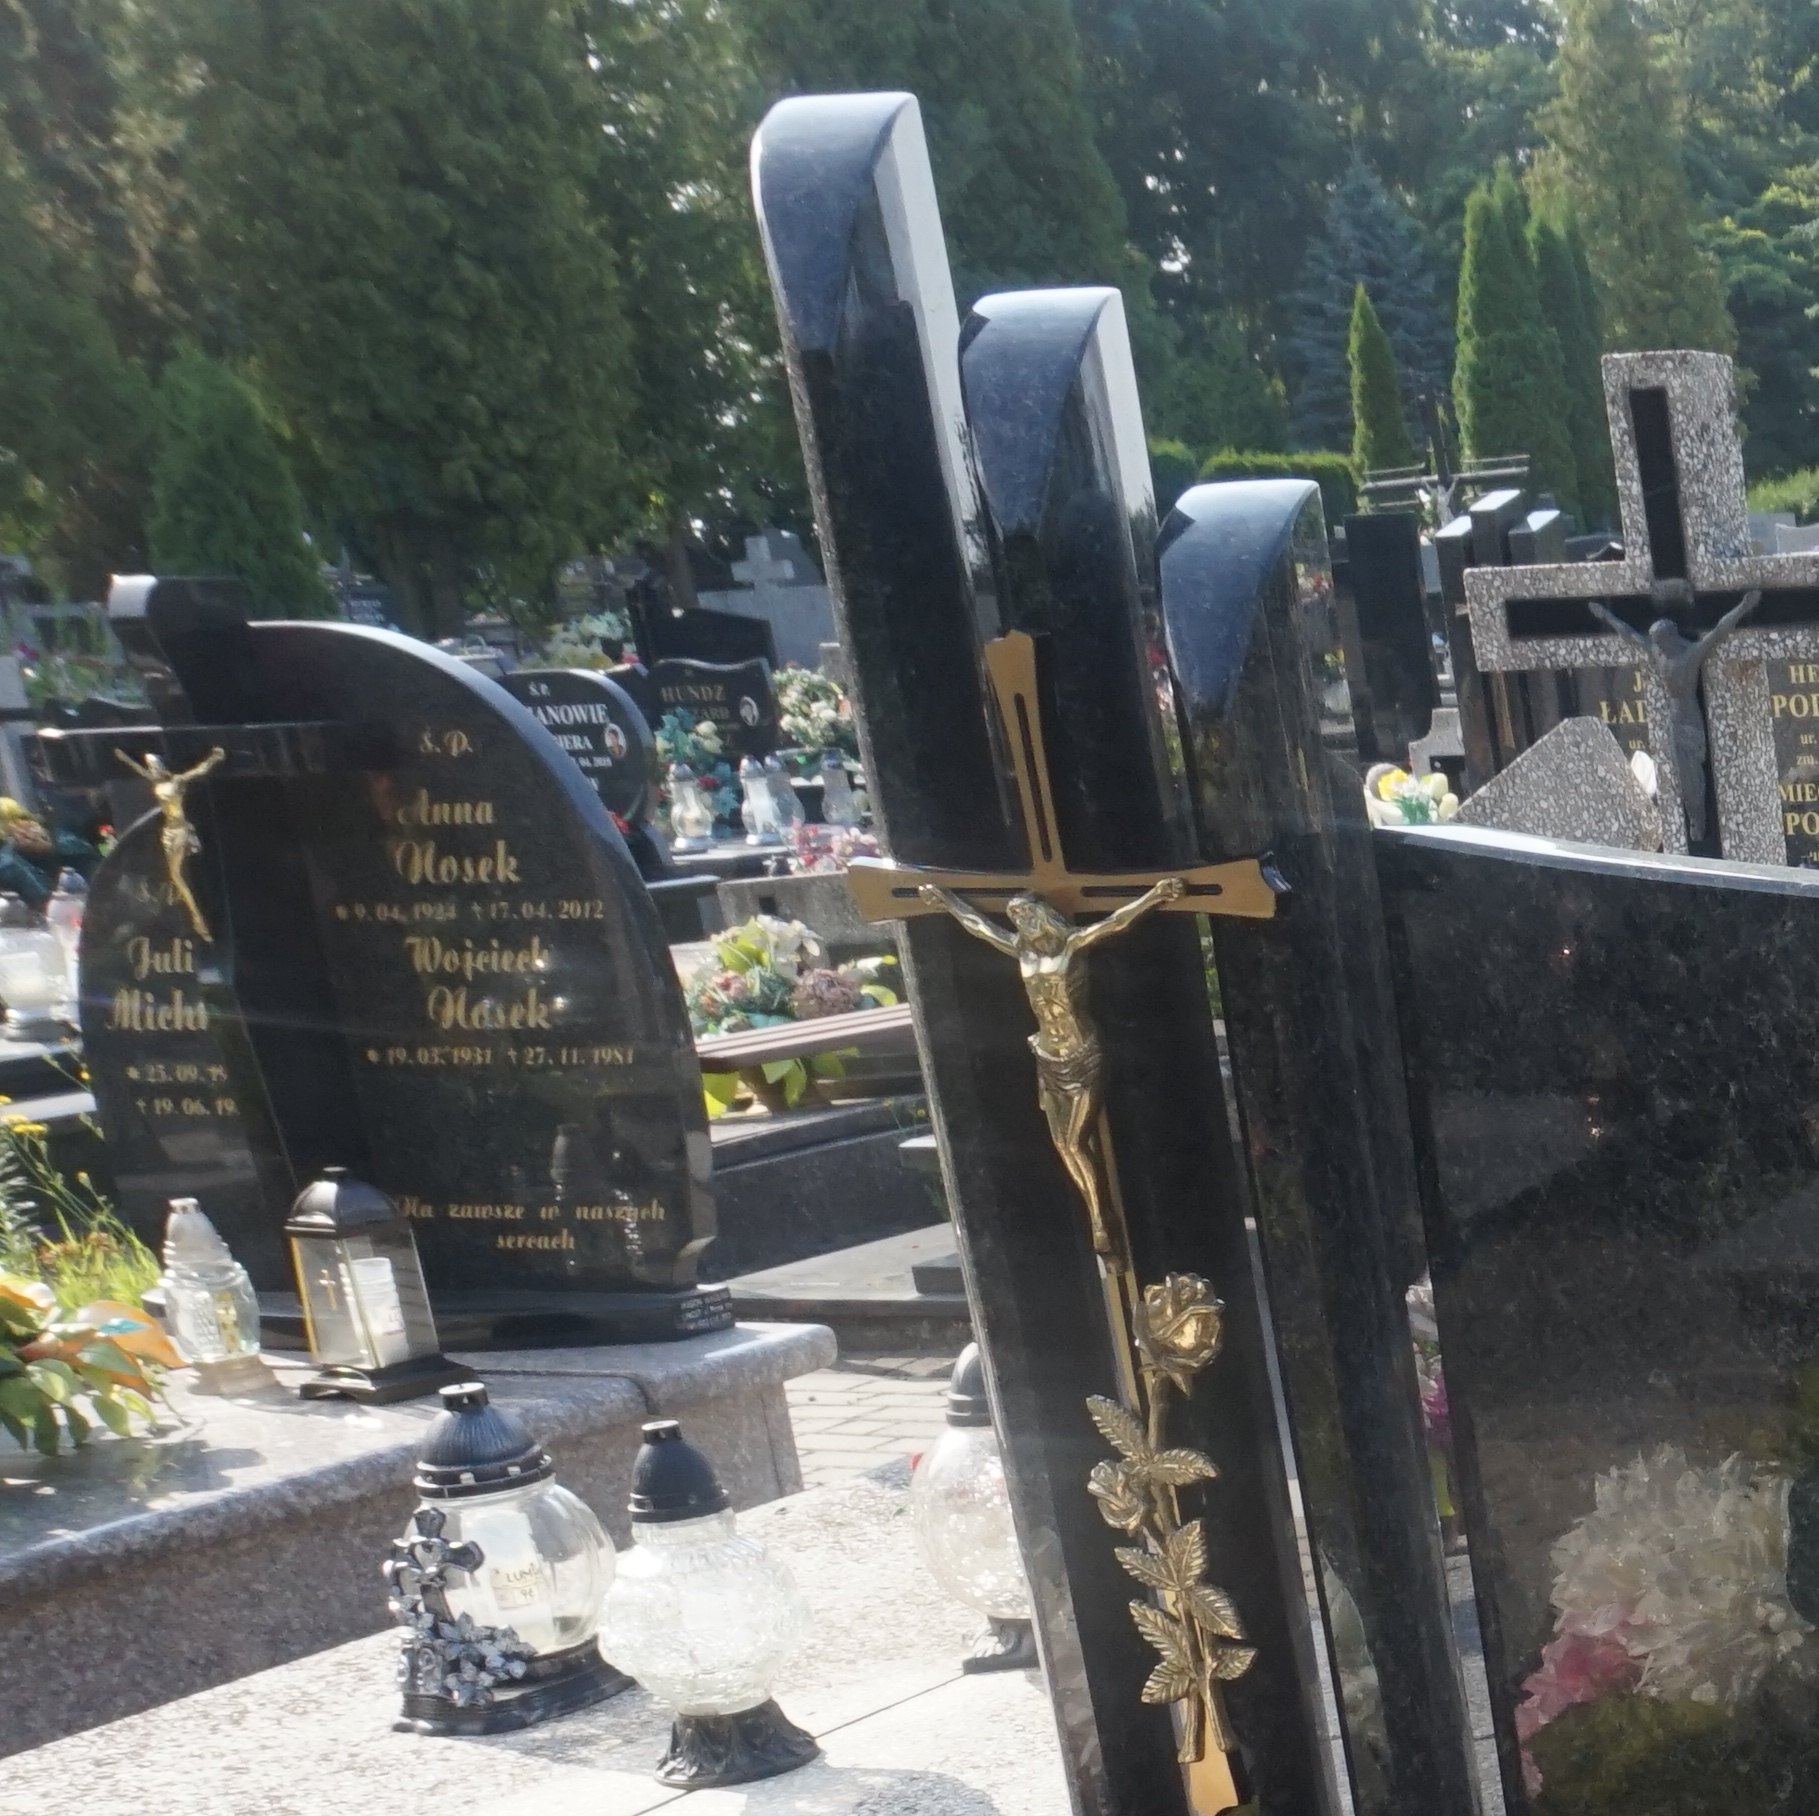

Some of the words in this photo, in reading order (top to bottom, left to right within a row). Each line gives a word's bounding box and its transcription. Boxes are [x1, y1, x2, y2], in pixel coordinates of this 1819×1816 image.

[397, 787, 494, 826] Anna
[395, 839, 522, 885] Nosek
[427, 986, 551, 1030] Nosek
